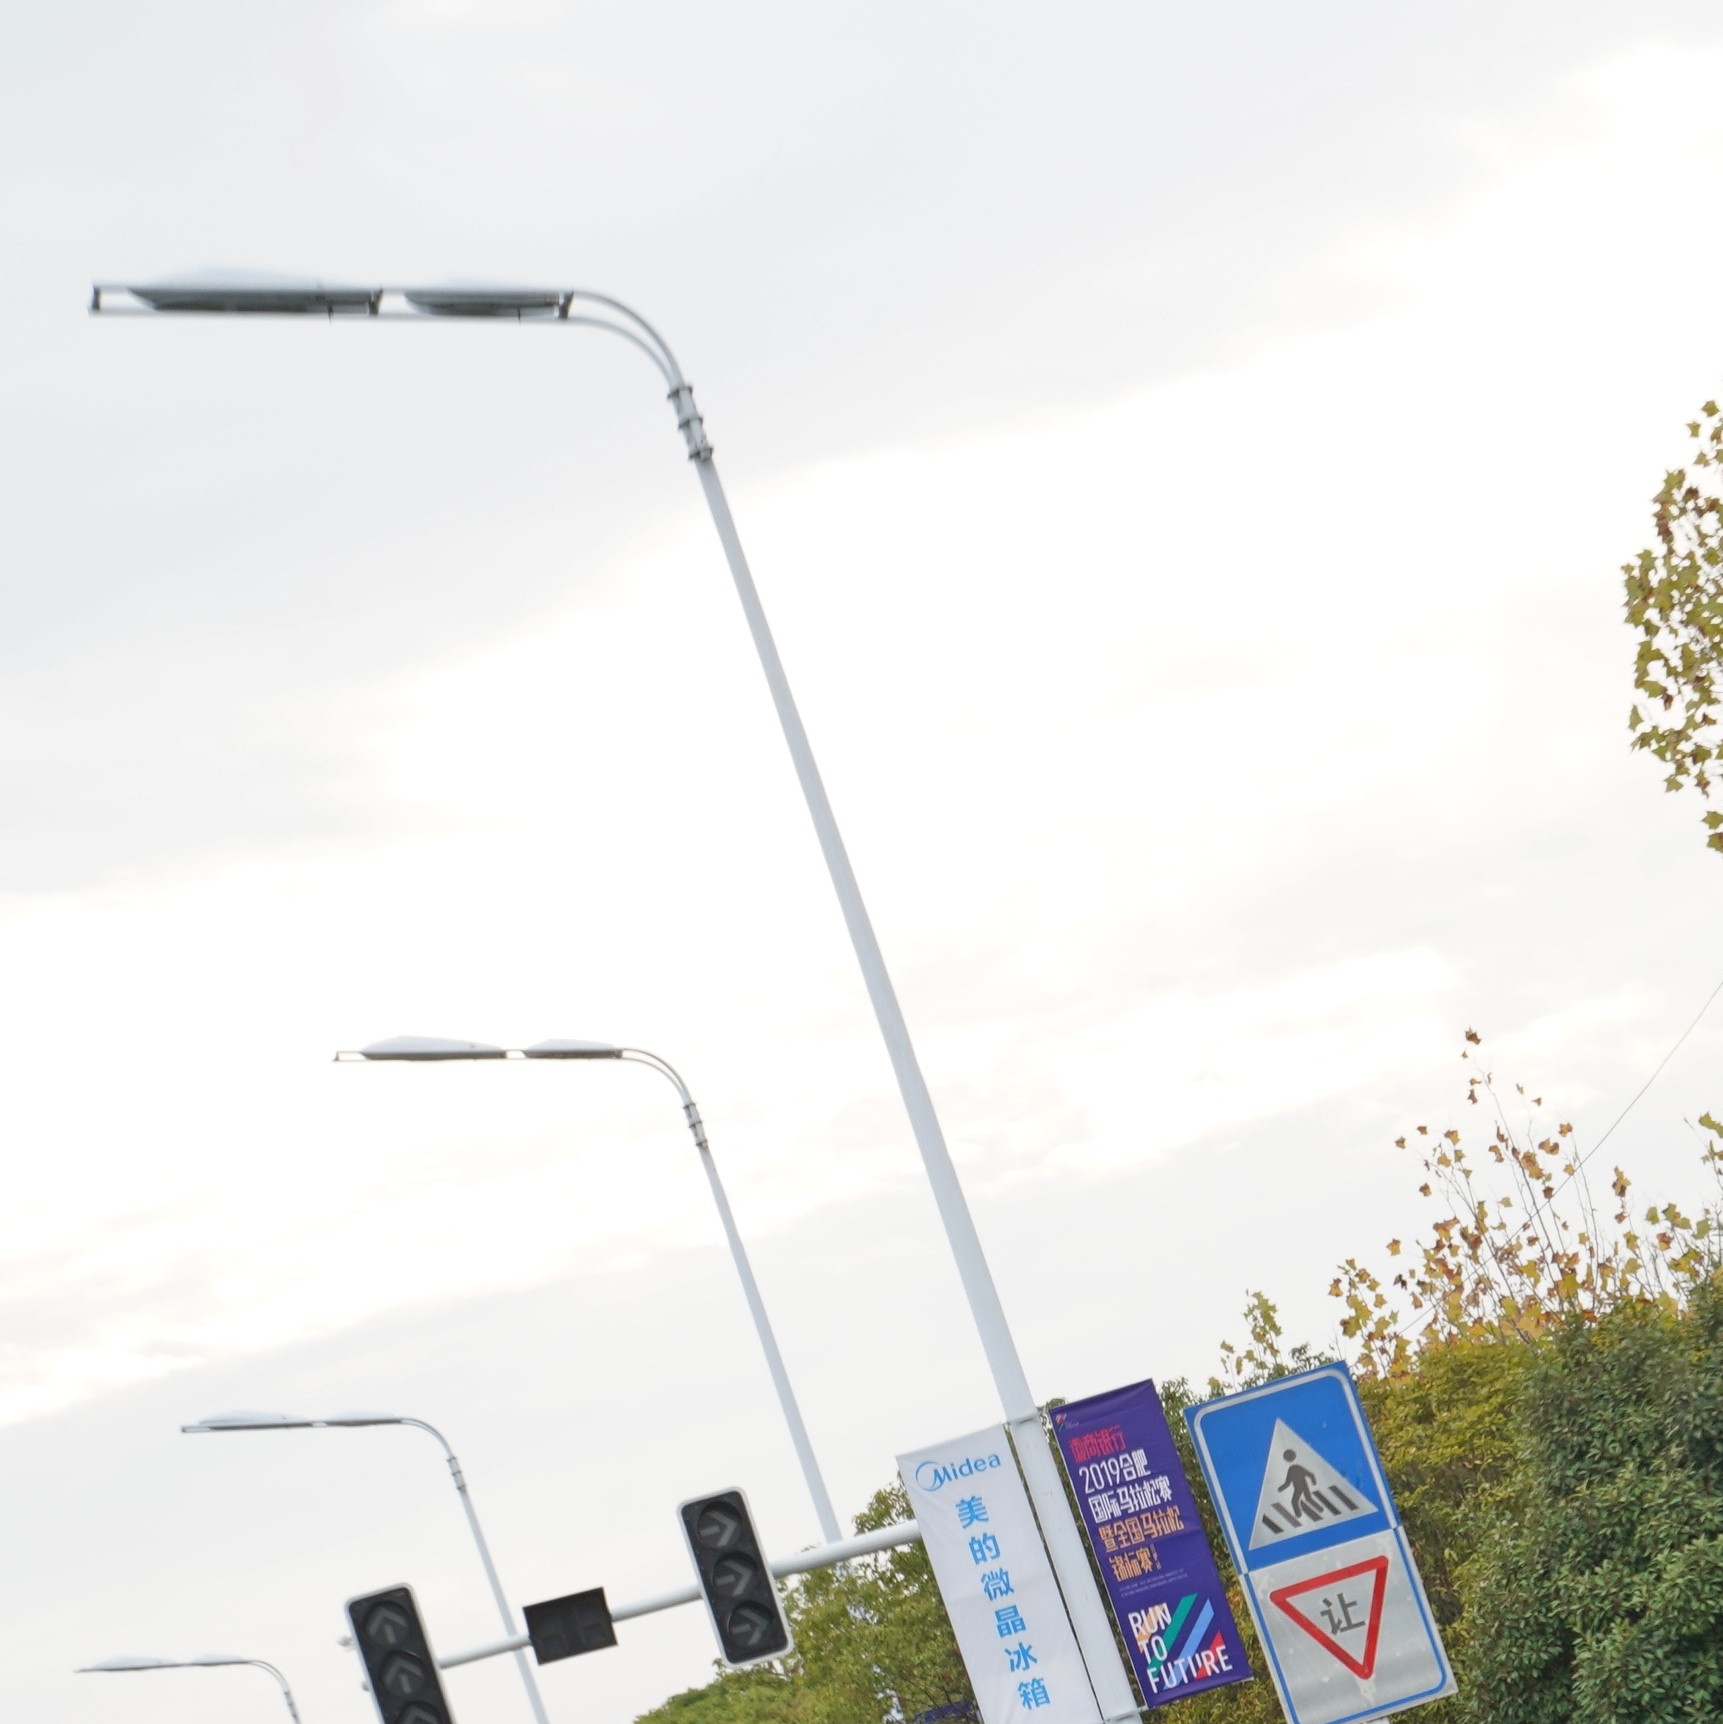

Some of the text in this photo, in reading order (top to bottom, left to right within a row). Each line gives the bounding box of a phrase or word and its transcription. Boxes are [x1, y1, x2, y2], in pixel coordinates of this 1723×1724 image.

[915, 1453, 1002, 1492] Midea
[1078, 1448, 1152, 1495] 2019合肥
[955, 1494, 1052, 1712] 美的微晶冰箱
[1127, 1602, 1172, 1638] RUN
[1320, 1592, 1367, 1636] 让
[1138, 1635, 1168, 1665] TO
[1146, 1644, 1233, 1694] FUTURE
